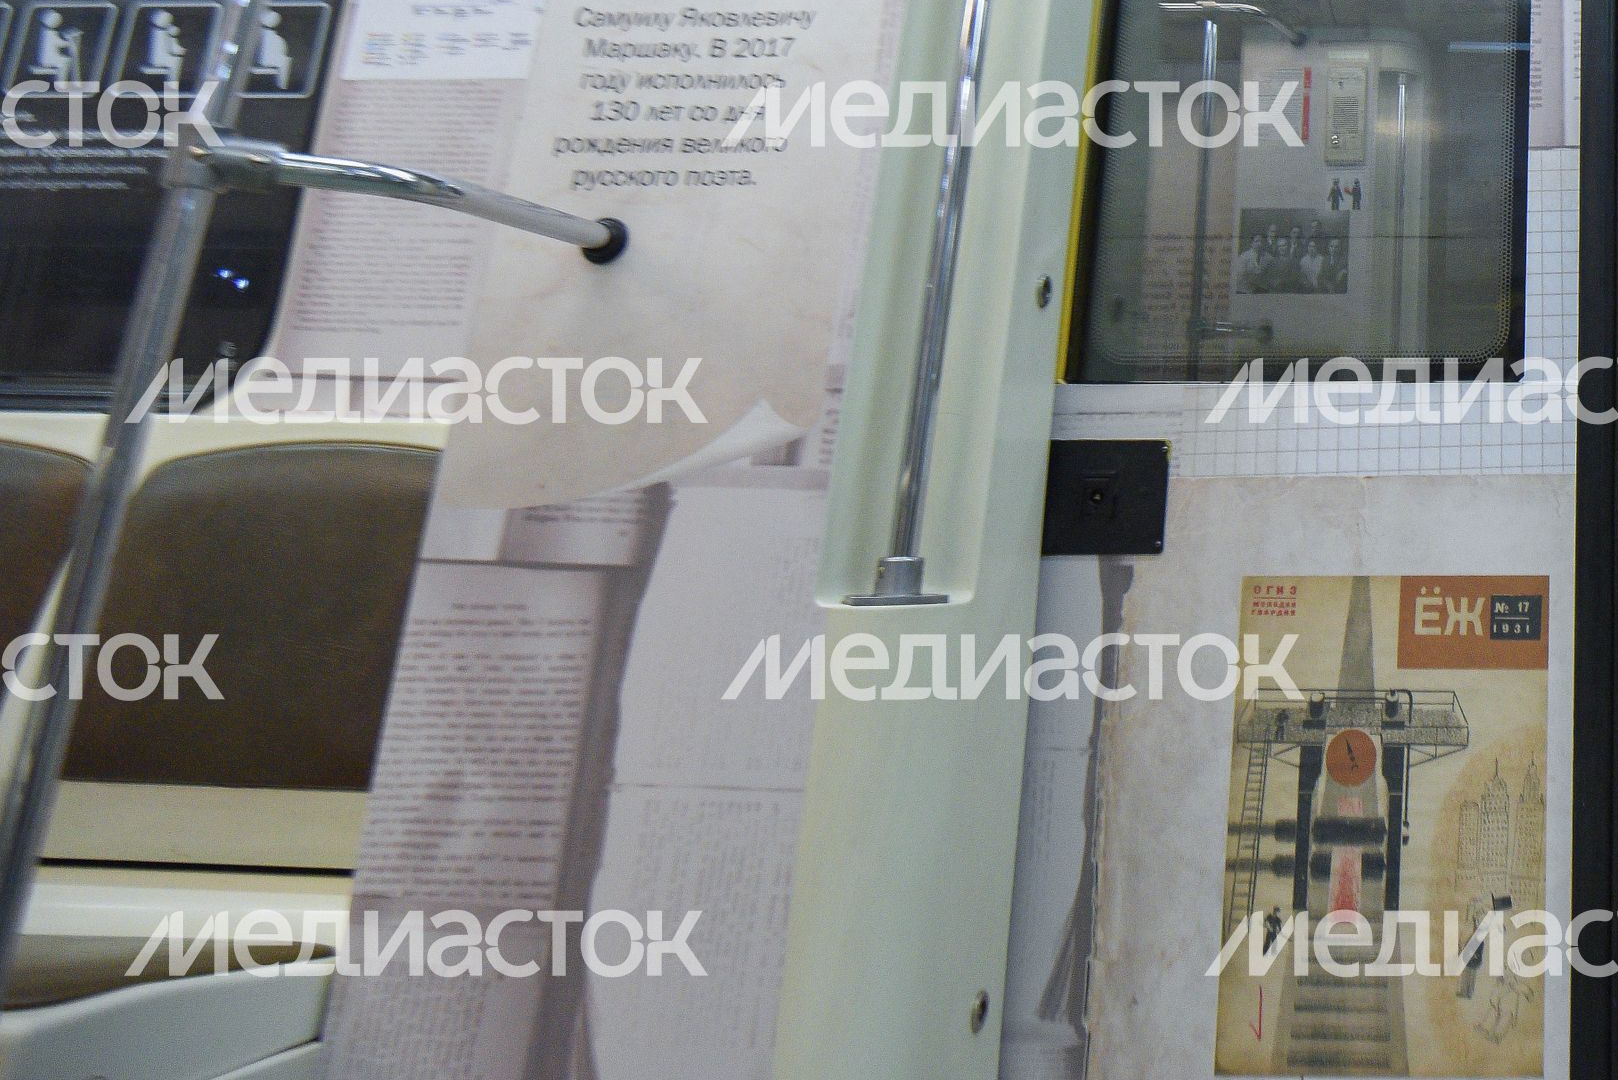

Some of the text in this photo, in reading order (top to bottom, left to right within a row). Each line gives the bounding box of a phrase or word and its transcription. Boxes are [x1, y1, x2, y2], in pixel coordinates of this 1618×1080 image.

[574, 7, 816, 31] Самуилу Яковлевичу
[583, 37, 795, 62] Маршаку. В 2017
[580, 74, 786, 93] году исполнилось
[591, 100, 640, 120] 130
[646, 106, 681, 120] лет
[688, 106, 718, 120] со
[553, 138, 787, 157] рождения великого
[572, 170, 756, 190] русского поэта.
[1414, 585, 1486, 636] ЁЖ
[1518, 601, 1530, 613] 17
[1493, 623, 1530, 634] 1931
